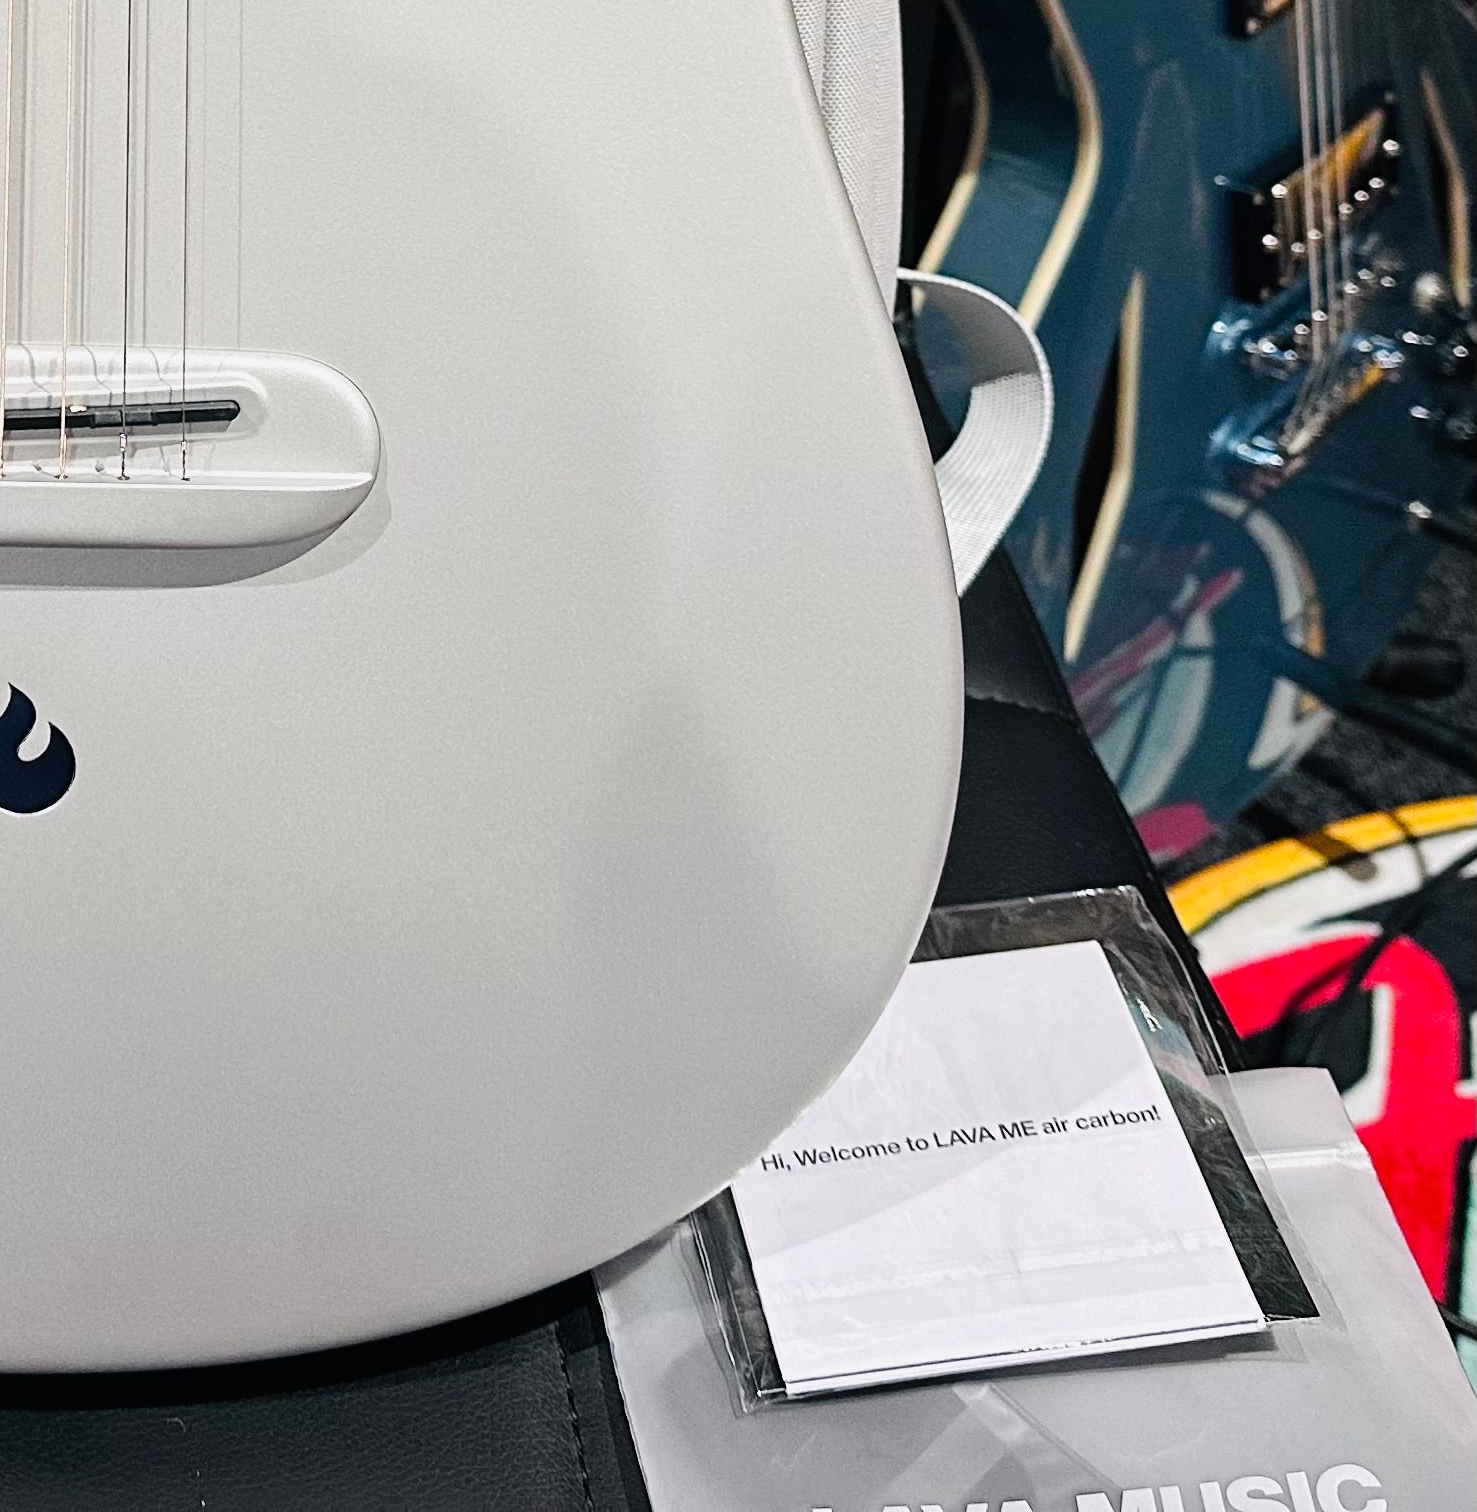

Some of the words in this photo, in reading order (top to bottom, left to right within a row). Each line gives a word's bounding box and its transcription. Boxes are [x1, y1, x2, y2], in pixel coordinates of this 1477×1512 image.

[760, 1153, 792, 1172] Hi,
[793, 1141, 901, 1167] Welcome
[905, 1137, 929, 1152] to
[932, 1125, 996, 1148] LAVA
[997, 1119, 1039, 1140] ME
[1042, 1116, 1069, 1135] air
[1075, 1104, 1163, 1131] carbon!
